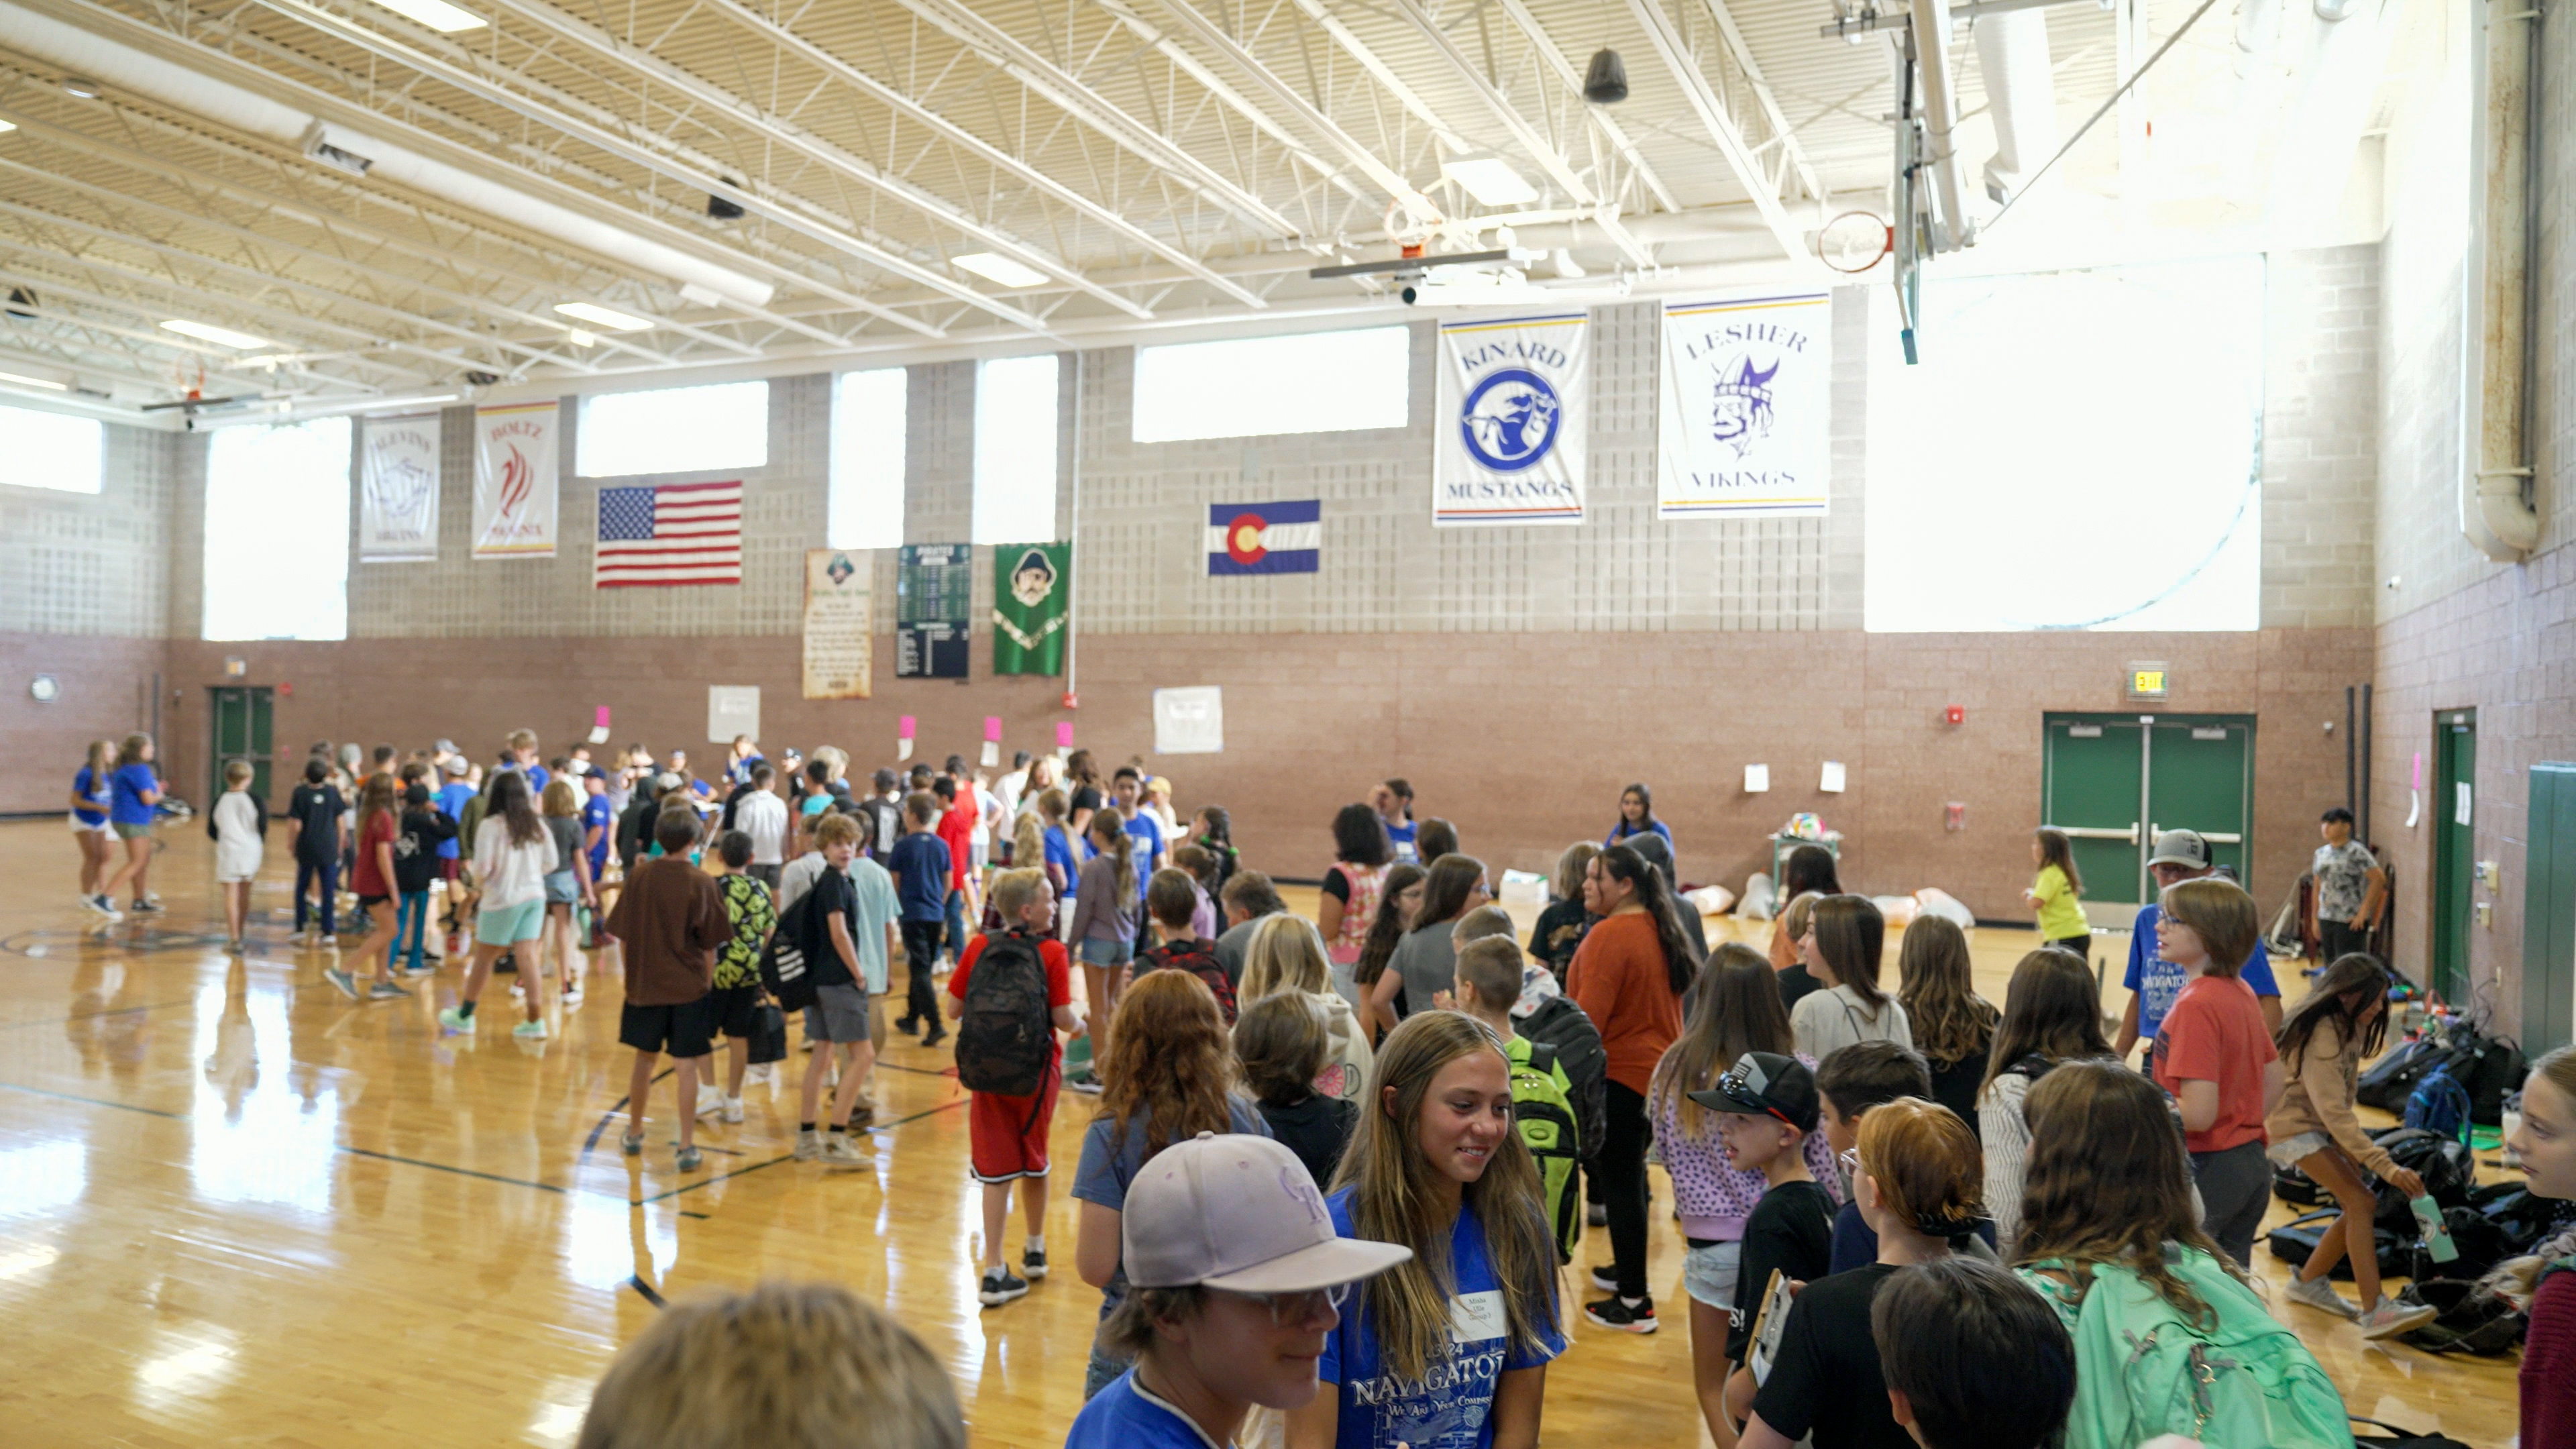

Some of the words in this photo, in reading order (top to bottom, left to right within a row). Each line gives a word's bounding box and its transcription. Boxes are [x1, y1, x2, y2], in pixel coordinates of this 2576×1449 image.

[1685, 323, 1807, 360] LESHER
[1461, 342, 1566, 371] KINARD
[1446, 479, 1572, 500] MUSTANGS
[1690, 471, 1796, 488] VIKINGS
